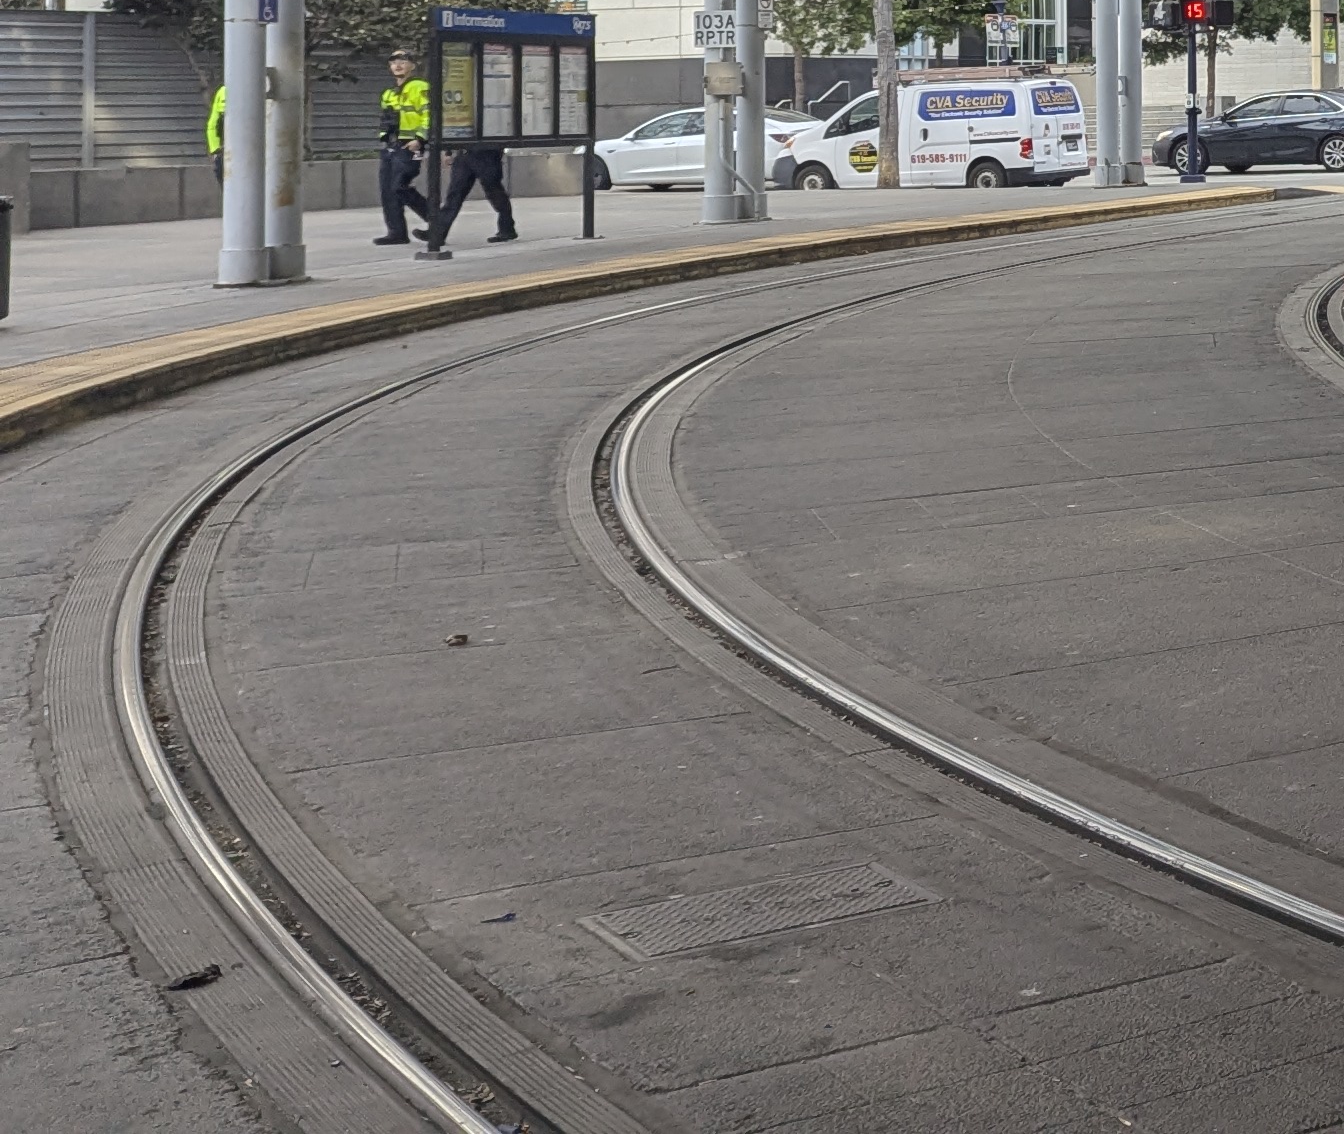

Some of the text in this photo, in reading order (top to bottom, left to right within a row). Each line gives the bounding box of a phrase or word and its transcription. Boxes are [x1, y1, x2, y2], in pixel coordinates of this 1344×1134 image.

[1187, 3, 1203, 18] 15
[454, 13, 506, 28] Information
[695, 14, 735, 29] 103A
[927, 93, 1009, 109] CVA Security
[910, 154, 967, 163] 619-585-9111
